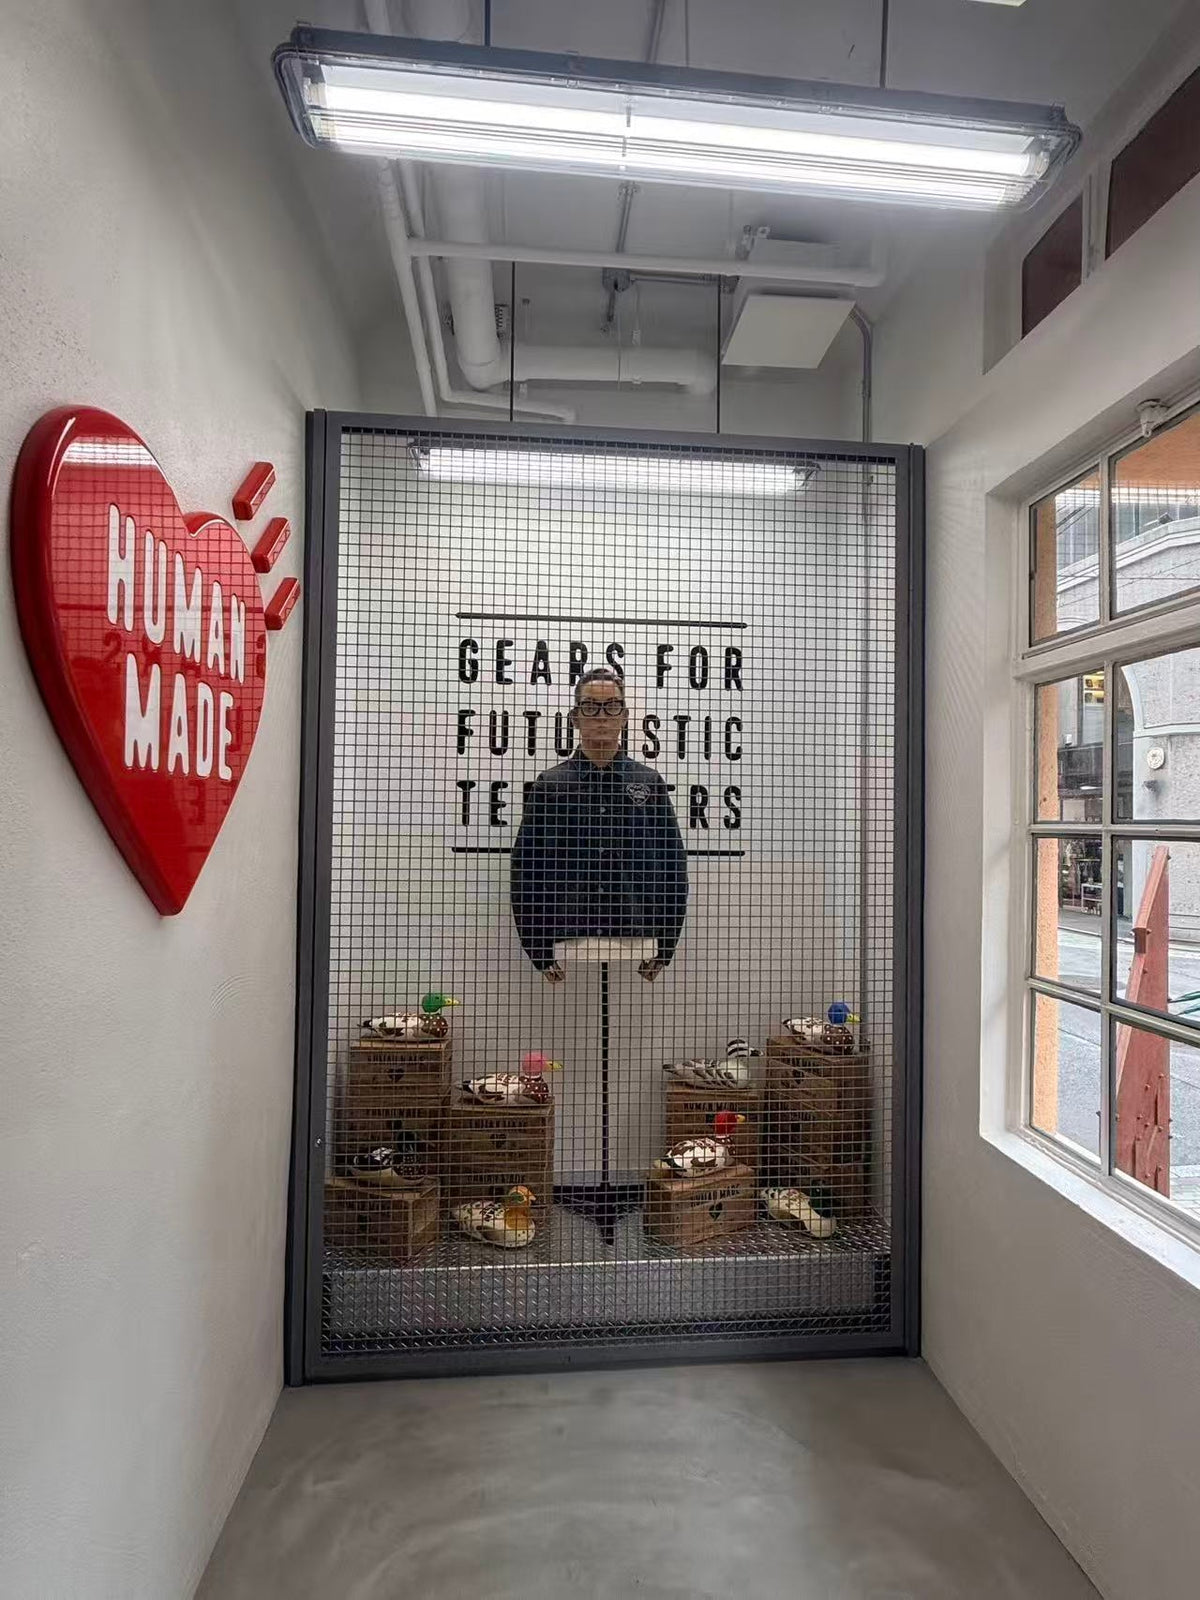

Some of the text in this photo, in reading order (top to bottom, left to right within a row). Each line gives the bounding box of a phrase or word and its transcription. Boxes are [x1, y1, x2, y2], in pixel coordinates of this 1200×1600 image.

[107, 503, 246, 684] HUMAN
[458, 638, 744, 691] GEARS FOR
[124, 652, 234, 781] MADE
[456, 709, 743, 761] FUTUISTIC
